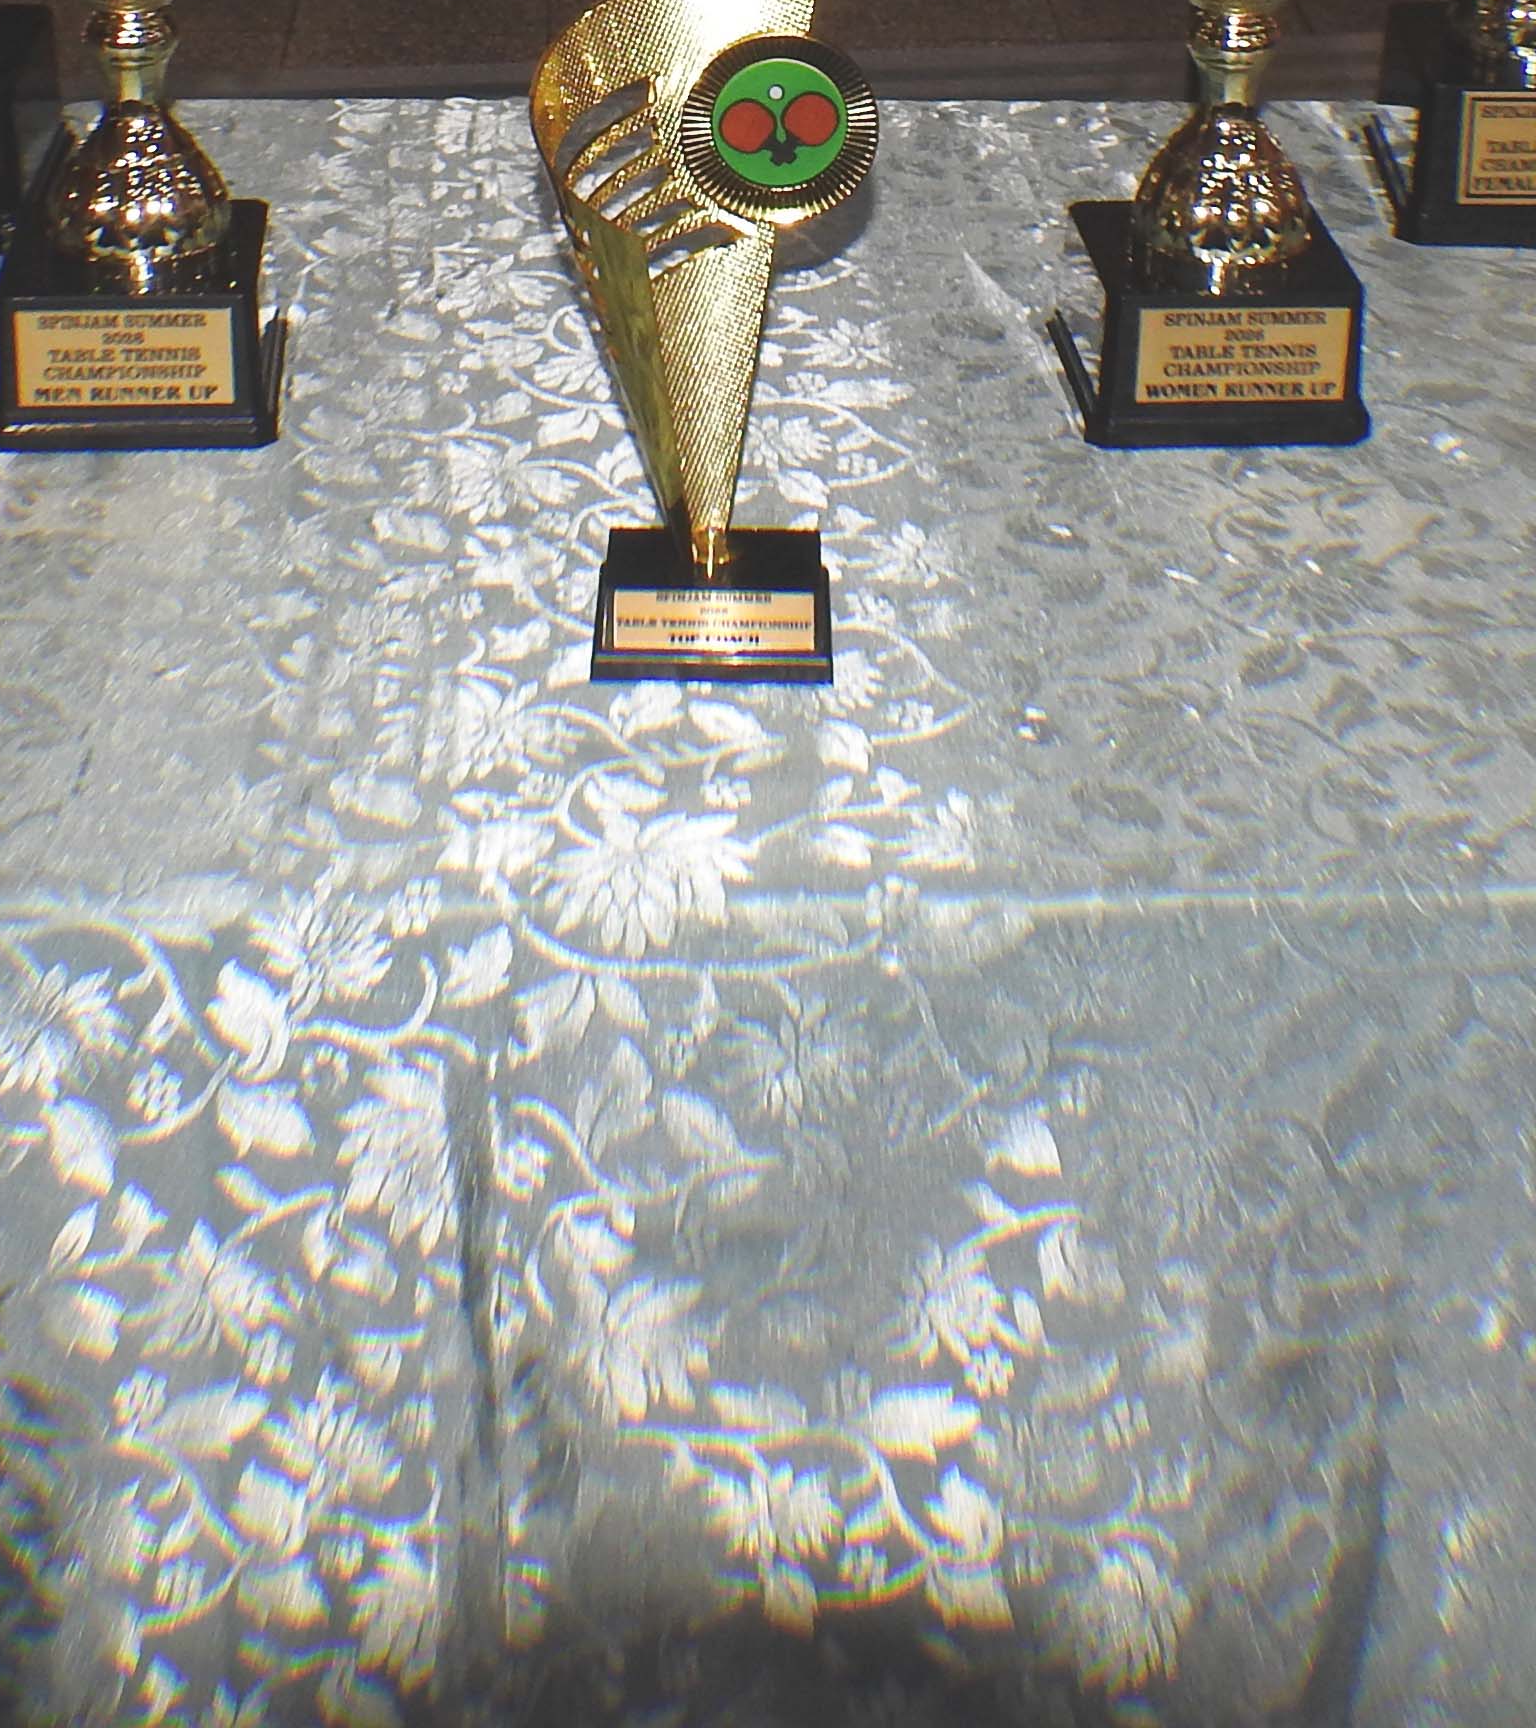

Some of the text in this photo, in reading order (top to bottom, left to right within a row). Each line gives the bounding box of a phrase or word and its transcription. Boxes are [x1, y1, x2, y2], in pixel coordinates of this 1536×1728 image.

[123, 313, 208, 328] SUMMER
[1163, 311, 1328, 327] SPINJAM SUMMER
[47, 347, 202, 363] TABLE TENNIS
[1168, 343, 1317, 360] TABLE TENNIS
[42, 365, 208, 380] CHAMPIONSHIP
[1162, 360, 1322, 377] CHAMPIONSHIP
[33, 384, 219, 403] MEN RUNNER UP
[1145, 381, 1337, 399] WOMEN RUNNER UP
